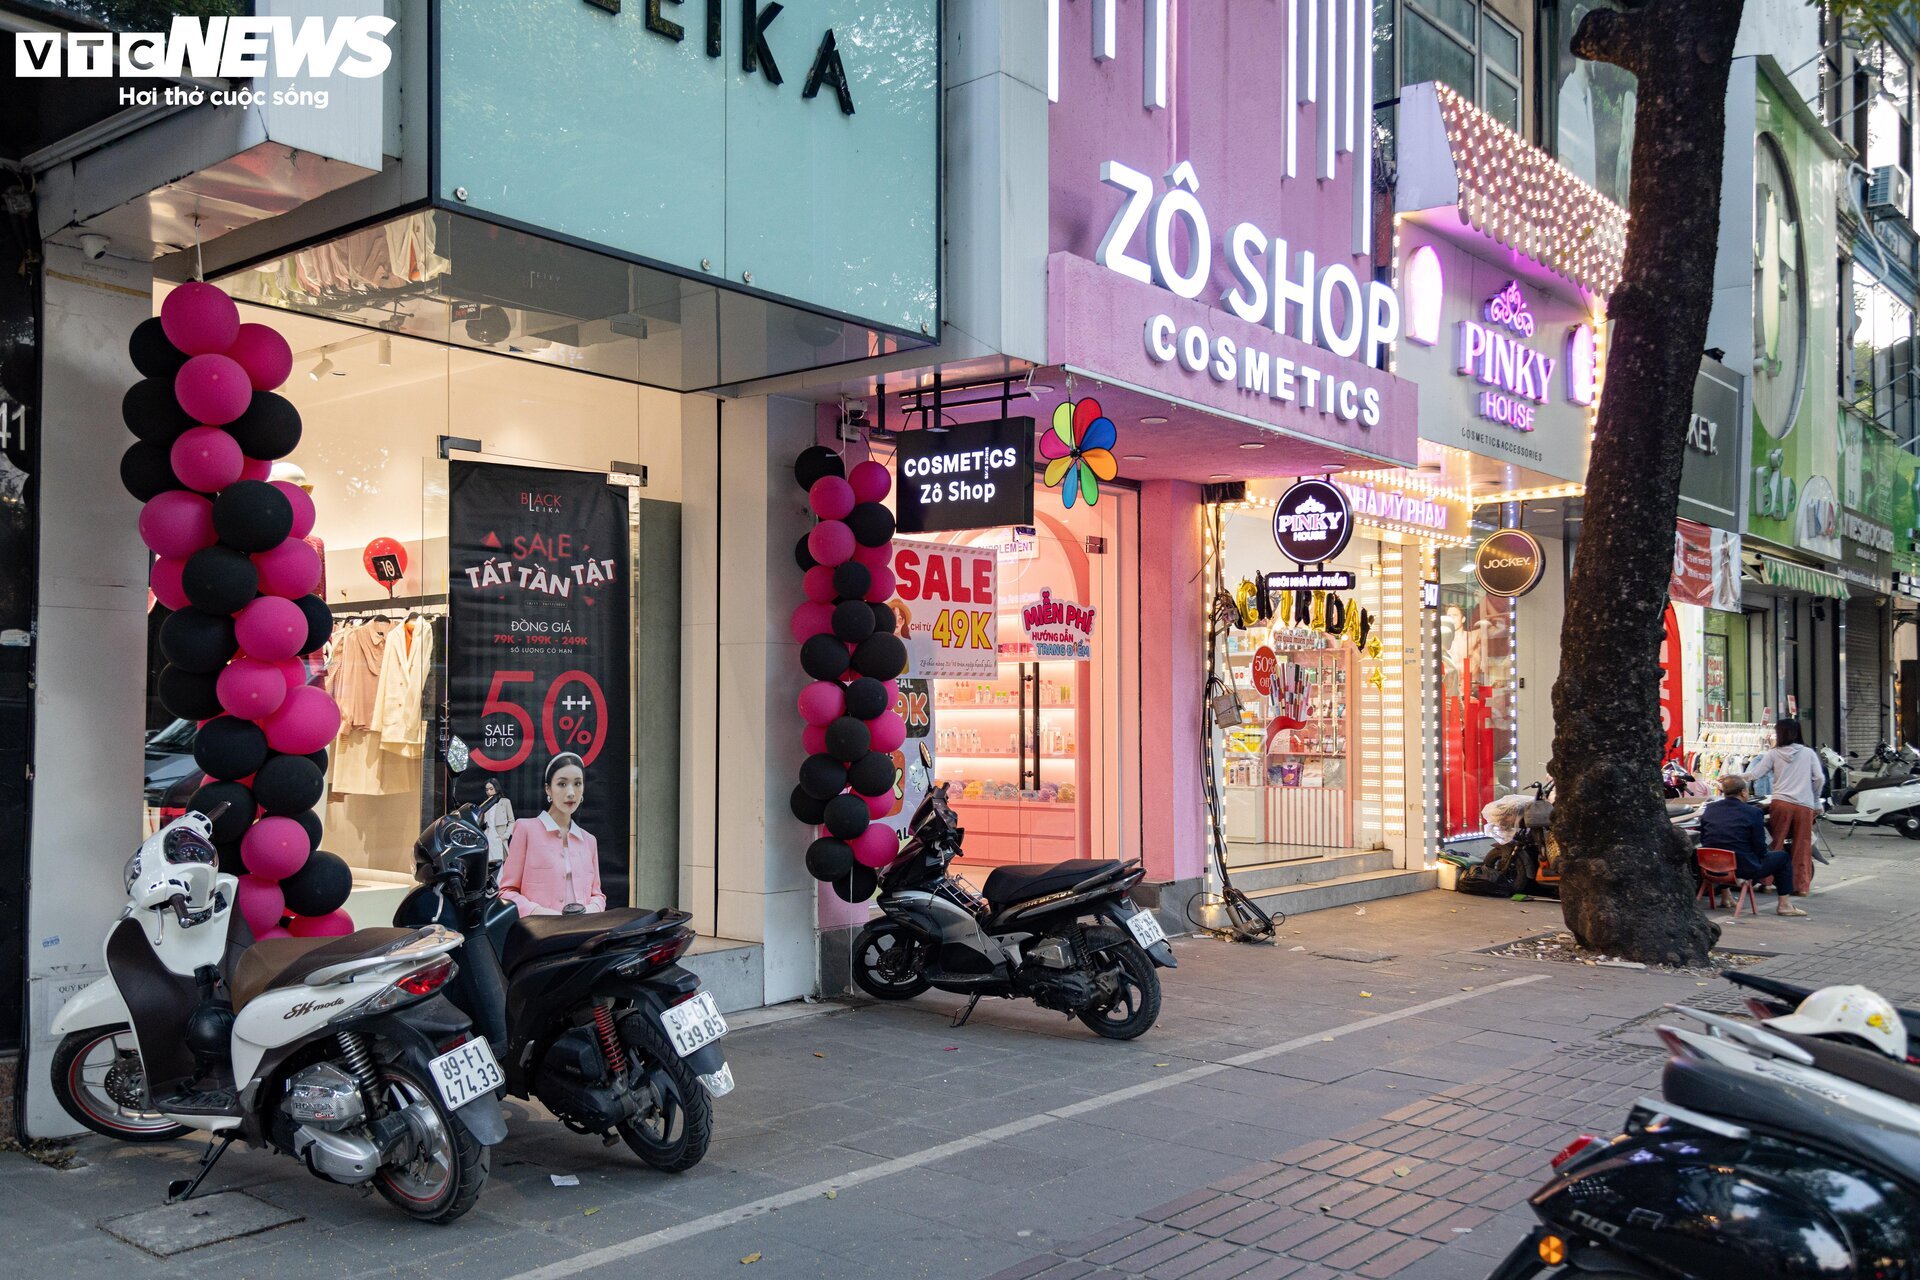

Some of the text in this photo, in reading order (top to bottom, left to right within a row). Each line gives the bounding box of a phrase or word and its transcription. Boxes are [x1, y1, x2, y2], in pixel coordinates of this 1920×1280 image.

[583, 0, 856, 116] EIKA
[1096, 160, 1400, 368] ZÔ SHOP
[1144, 314, 1380, 428] COSMETICS
[1458, 320, 1556, 405] PINKY
[1480, 391, 1535, 432] HOUSE
[904, 447, 1016, 478] COSMETICS
[920, 481, 996, 504] Zô Shop
[1278, 511, 1343, 533] PINKY
[1293, 530, 1327, 542] HOUSE
[512, 532, 572, 562] SALE
[465, 556, 616, 598] TẤT TẦN TẬT
[895, 550, 993, 604] SALE
[493, 634, 515, 644] 79K
[526, 635, 551, 645] 199K
[562, 636, 588, 646] 249K
[511, 618, 572, 633] ĐỒNG GIÁ
[932, 608, 993, 649] 49K
[1036, 643, 1066, 656] TRANG
[469, 670, 608, 772] 50
[484, 724, 514, 737] SALE
[484, 737, 514, 747] UP TO
[312, 997, 345, 1011] mode
[676, 1014, 724, 1052] 139.85
[440, 1046, 484, 1080] 89-F1
[445, 1063, 499, 1104] 474.33
